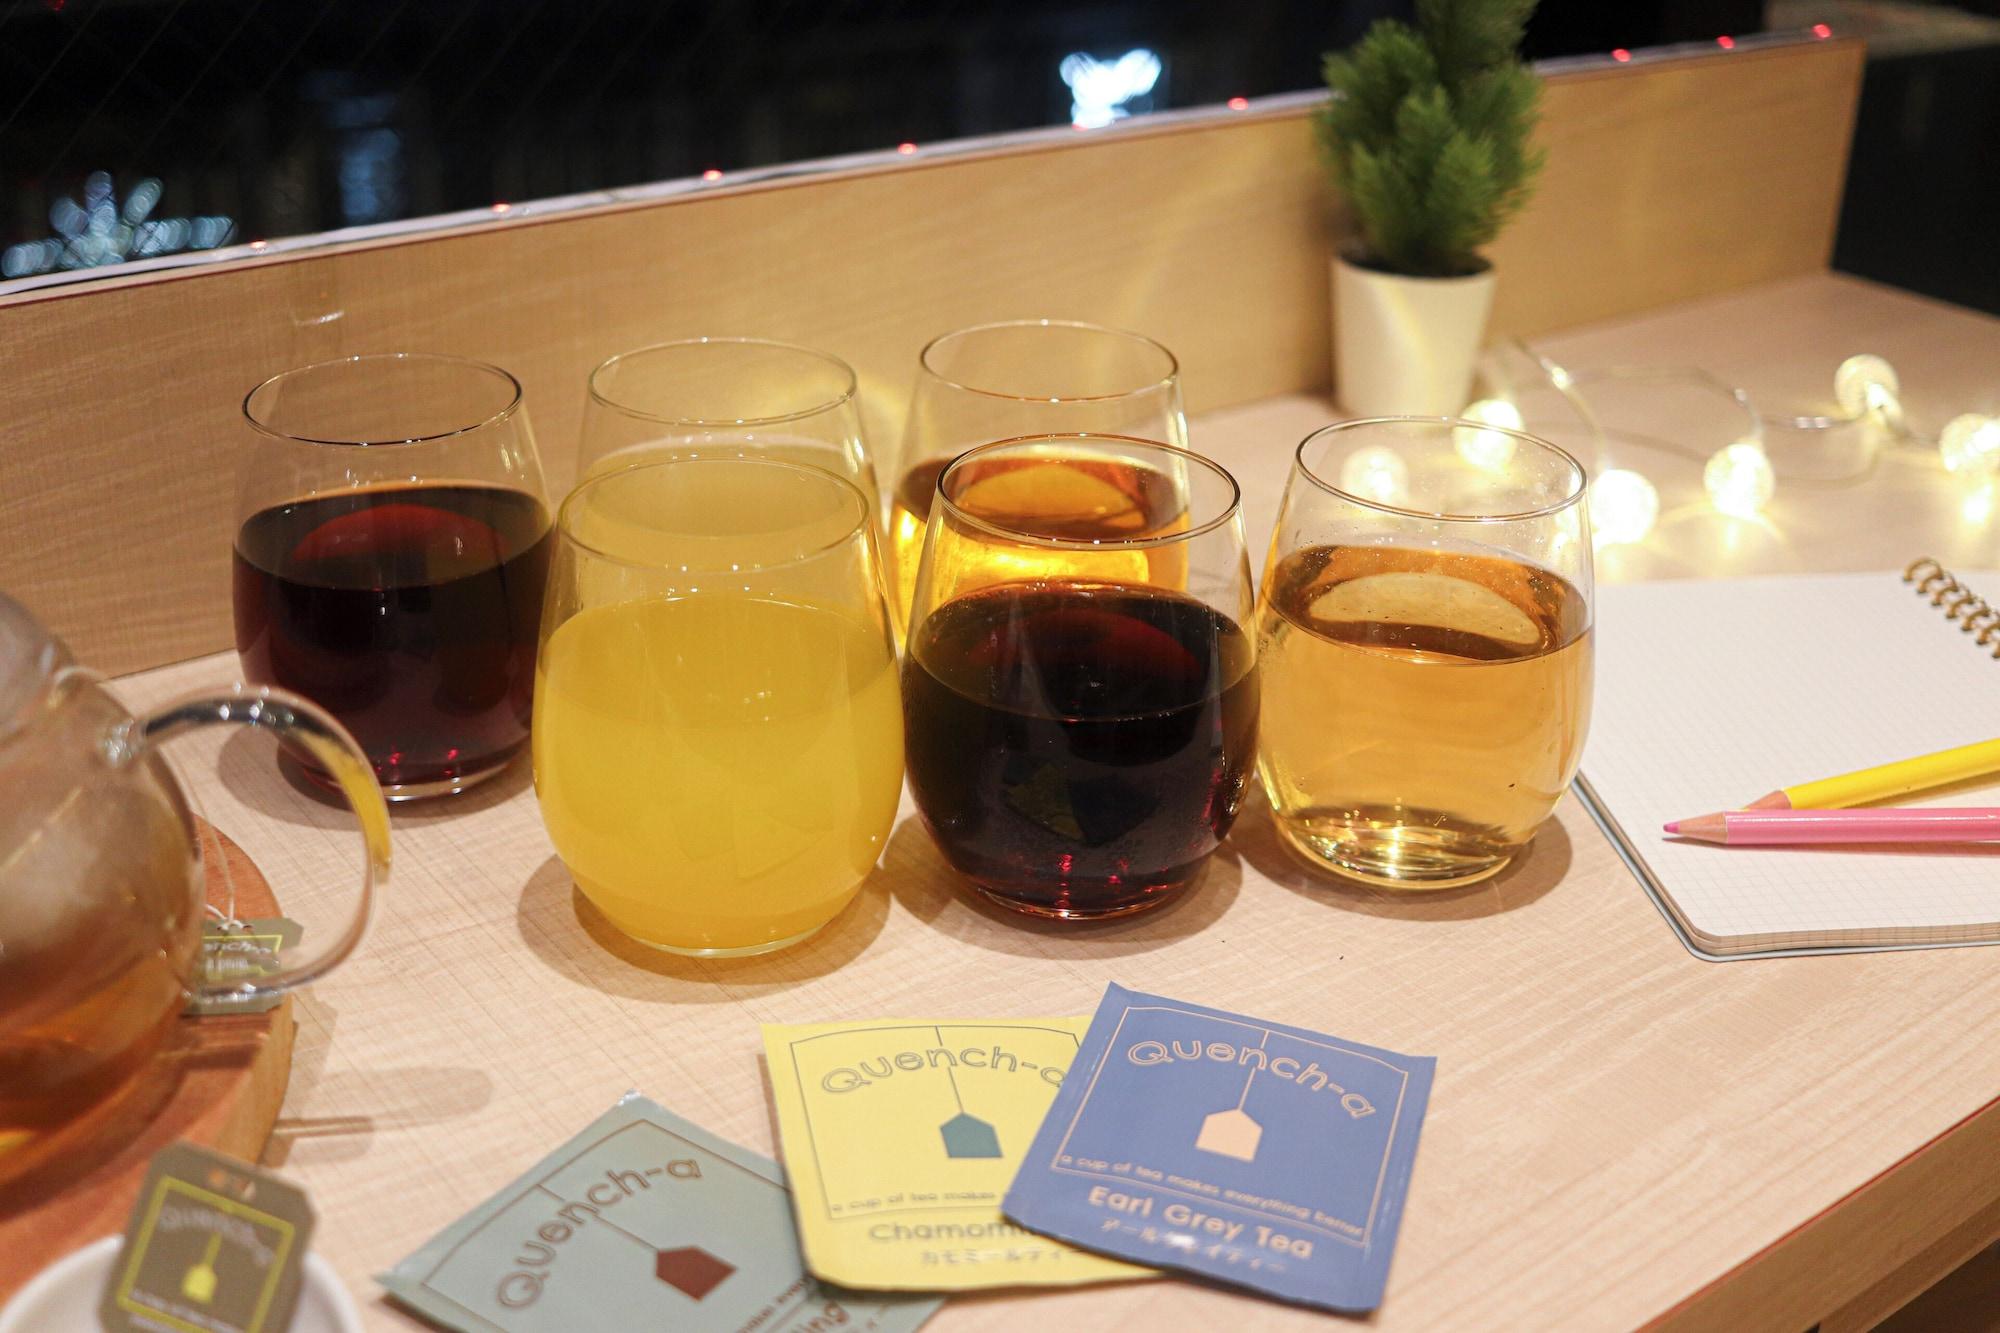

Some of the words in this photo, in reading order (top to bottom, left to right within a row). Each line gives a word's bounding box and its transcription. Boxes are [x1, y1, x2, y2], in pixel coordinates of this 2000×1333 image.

[1127, 1040, 1376, 1119] Quench-a
[831, 1204, 843, 1213] a
[849, 1199, 882, 1211] cup
[888, 1192, 904, 1203] of
[911, 1191, 938, 1201] tea
[1061, 1154, 1072, 1164] a
[1076, 1156, 1109, 1171] cup
[1112, 1161, 1132, 1174] of
[1135, 1165, 1163, 1182] tea
[1167, 1173, 1220, 1195] makes
[1223, 1187, 1312, 1220] everything
[1088, 1185, 1154, 1218] Earl
[1162, 1202, 1245, 1242] Grey
[1255, 1224, 1315, 1261] Tea
[496, 1158, 703, 1310] Quench-a
